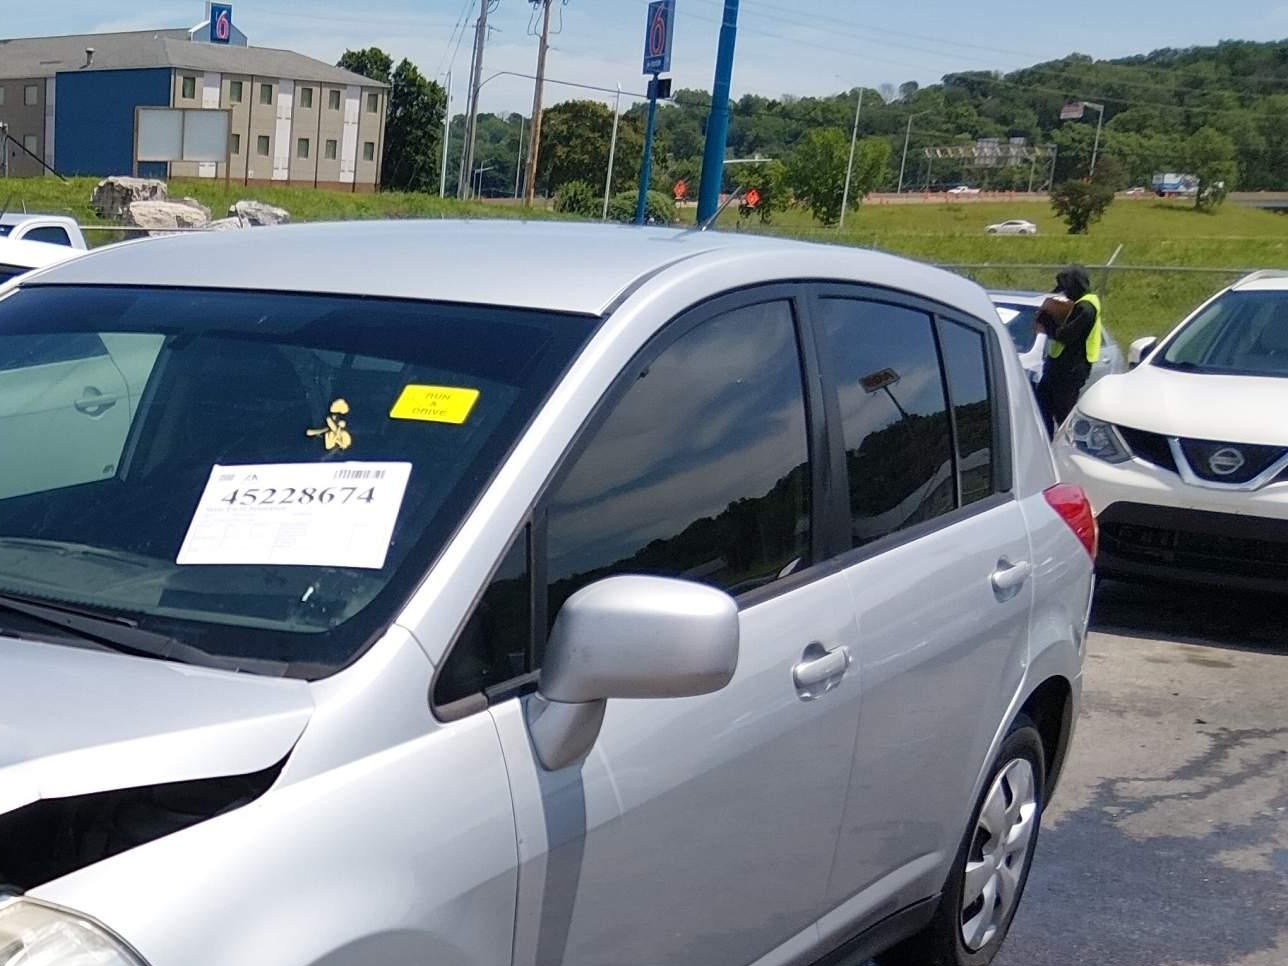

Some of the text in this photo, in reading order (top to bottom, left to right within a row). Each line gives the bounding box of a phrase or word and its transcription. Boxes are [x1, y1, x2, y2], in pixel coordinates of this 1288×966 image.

[216, 10, 229, 39] 6
[649, 2, 665, 57] 6
[425, 392, 450, 401] RUN
[412, 408, 448, 416] DRIVE
[221, 486, 375, 506] 45228674
